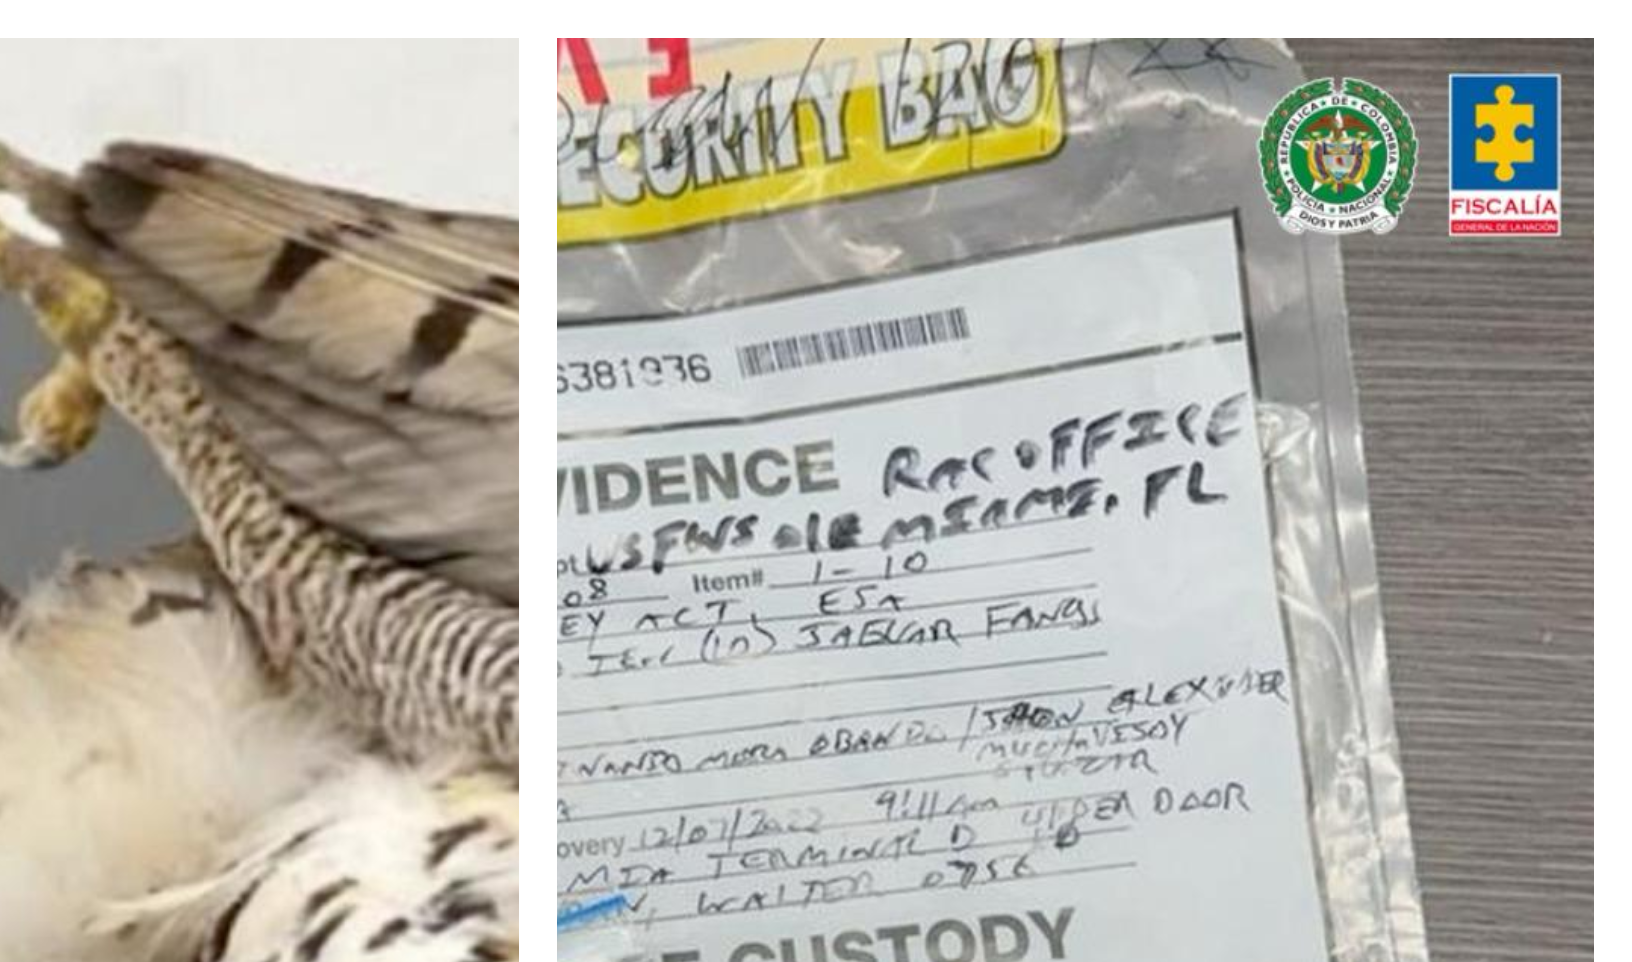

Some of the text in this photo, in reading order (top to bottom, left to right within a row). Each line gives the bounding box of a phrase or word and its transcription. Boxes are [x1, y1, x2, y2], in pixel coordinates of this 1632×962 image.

[878, 38, 1042, 150] BAG
[1014, 393, 1247, 470] OFFICE
[1144, 461, 1228, 518] FL
[691, 568, 765, 594] Item#
